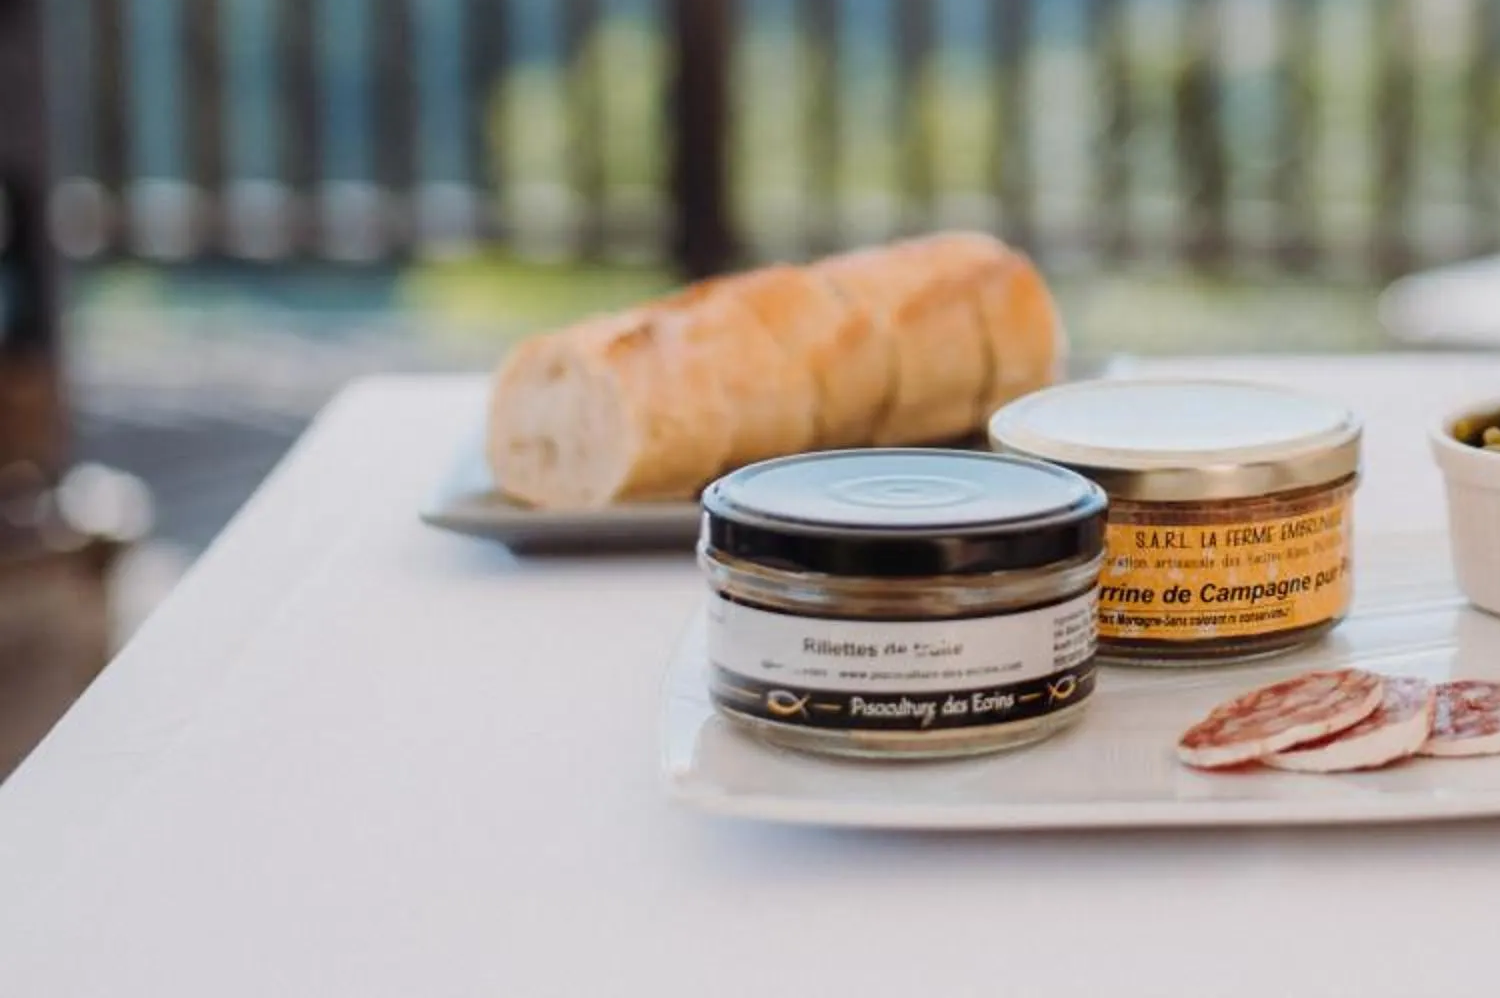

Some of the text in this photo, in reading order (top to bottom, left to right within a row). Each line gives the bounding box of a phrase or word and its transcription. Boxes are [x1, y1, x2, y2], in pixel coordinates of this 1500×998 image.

[1200, 530, 1217, 549] LA
[1225, 524, 1275, 547] FERME
[1100, 584, 1154, 604] rrine
[1163, 585, 1191, 604] de
[1200, 573, 1311, 604] Campagne
[1314, 566, 1338, 593] pur
[803, 637, 879, 657] Rillettes
[941, 693, 969, 715] des
[971, 690, 1015, 713] Ecrins
